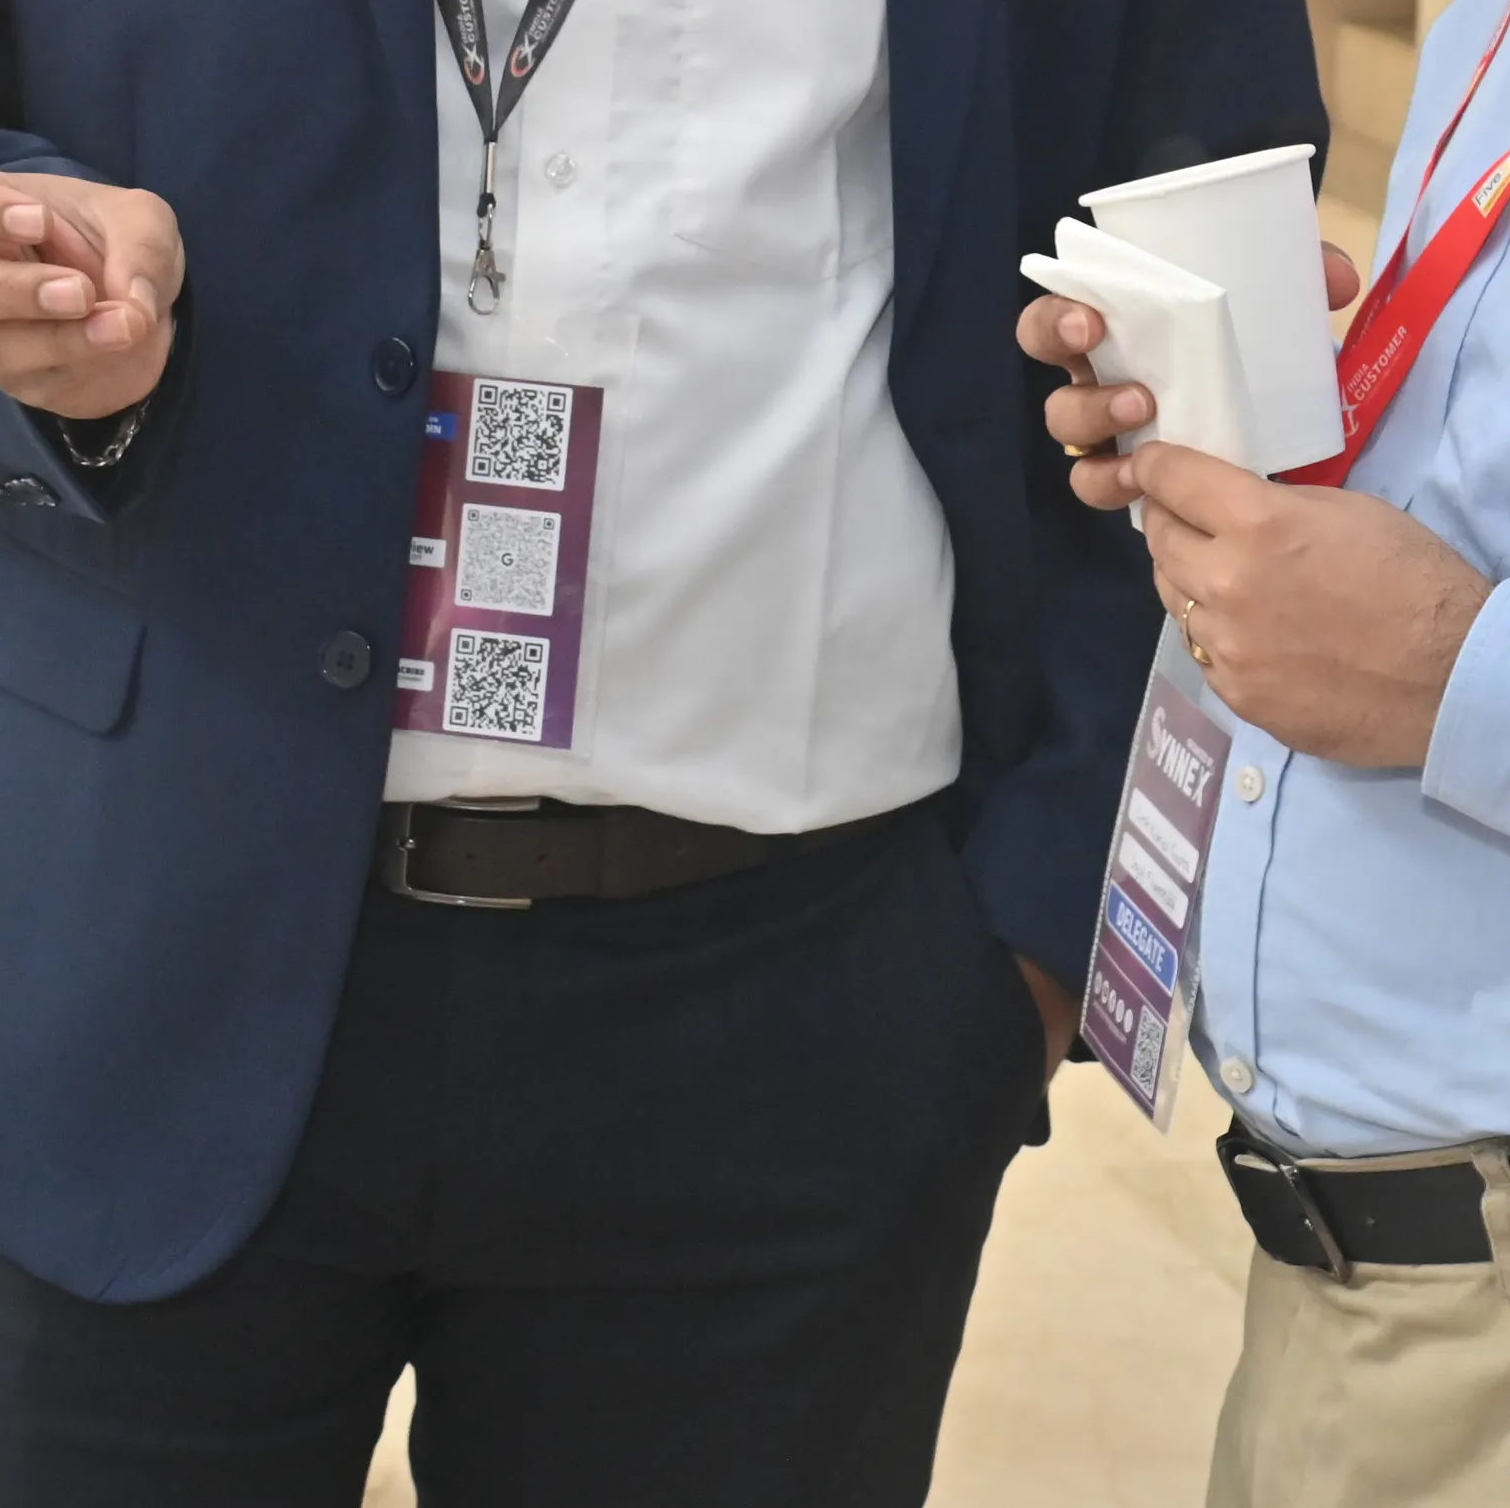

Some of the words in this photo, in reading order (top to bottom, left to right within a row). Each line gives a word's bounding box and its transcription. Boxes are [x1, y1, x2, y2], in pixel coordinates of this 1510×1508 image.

[1347, 363, 1370, 393] INDIA
[1354, 325, 1407, 401] CUSTOMER
[1115, 901, 1166, 973] DELEGATE
